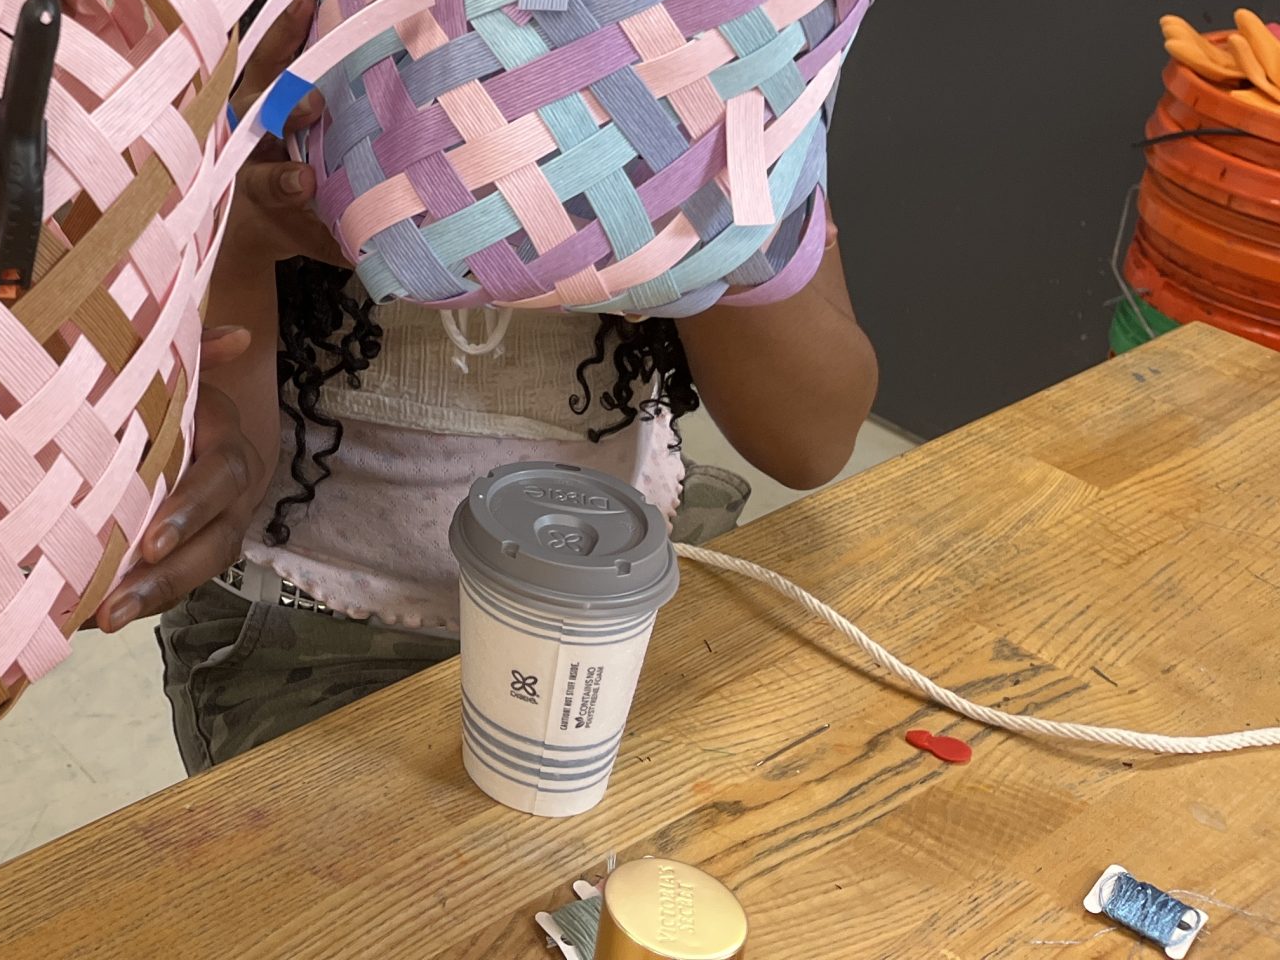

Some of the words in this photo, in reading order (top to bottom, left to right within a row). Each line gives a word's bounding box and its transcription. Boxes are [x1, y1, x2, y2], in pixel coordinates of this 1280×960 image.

[586, 666, 596, 679] NO
[579, 679, 594, 716] CONTAINS
[678, 882, 695, 934] SECRET
